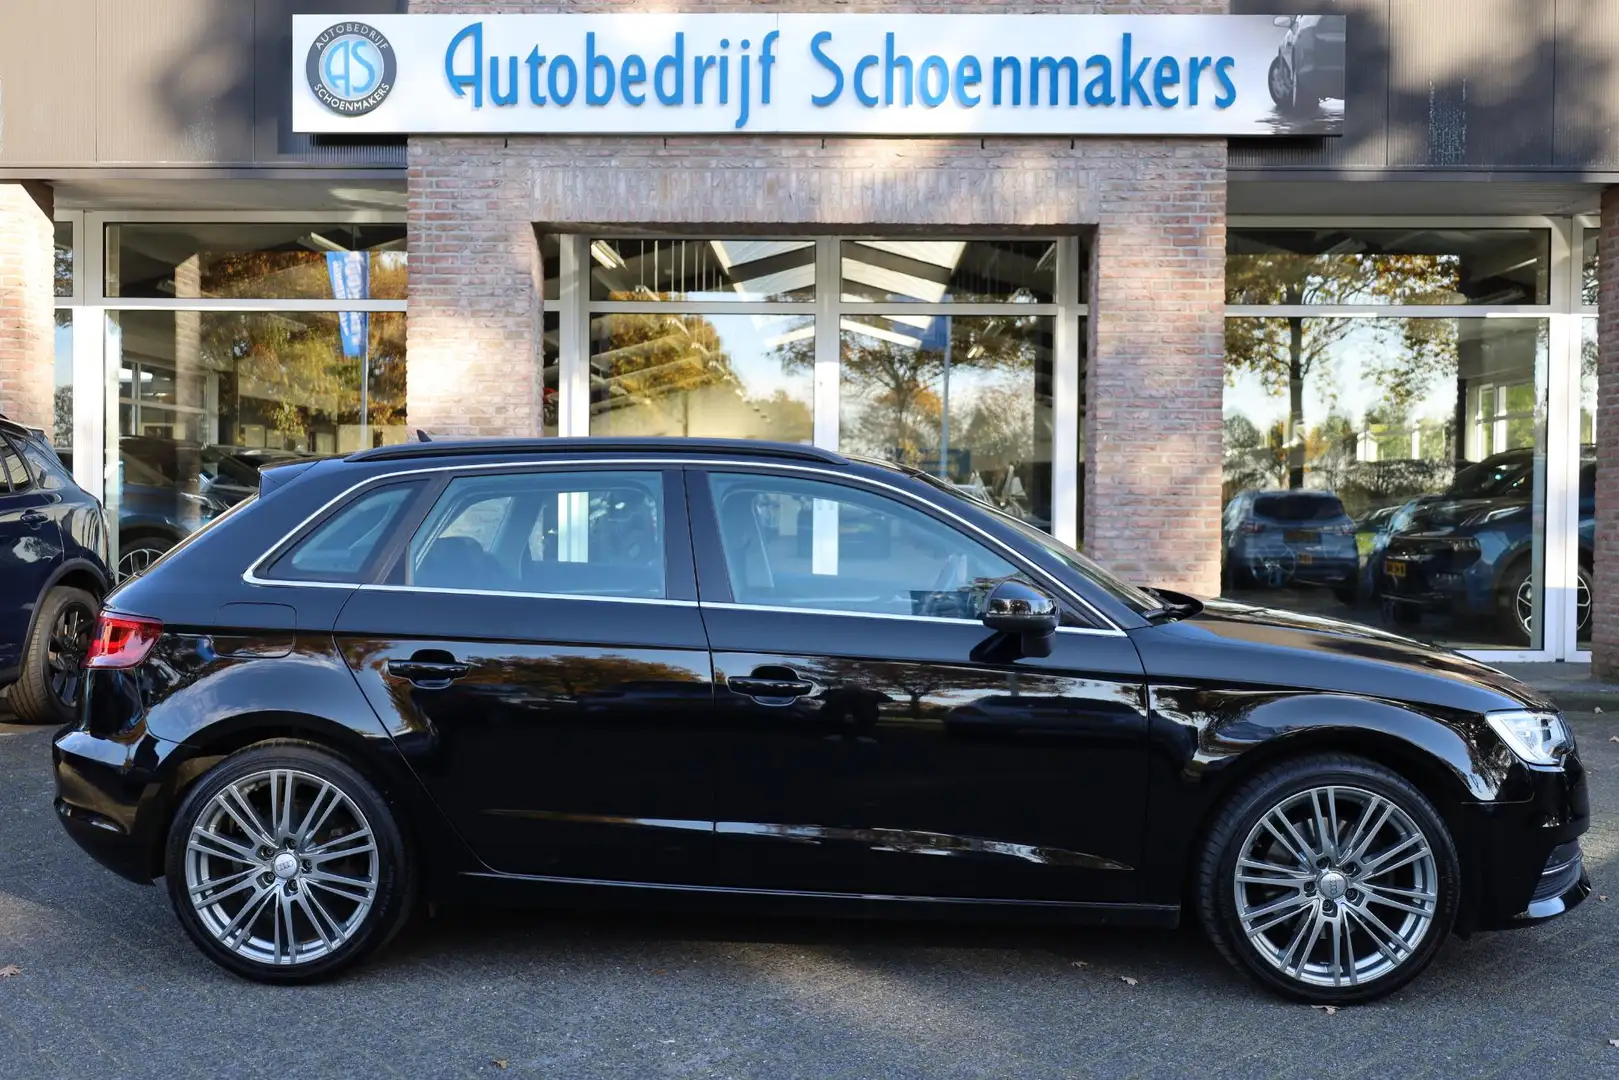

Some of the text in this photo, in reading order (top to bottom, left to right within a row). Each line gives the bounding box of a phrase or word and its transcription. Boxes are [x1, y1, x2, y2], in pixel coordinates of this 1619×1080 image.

[315, 24, 389, 50] AUTOBEDRIJF
[325, 40, 376, 97] AS
[445, 22, 1237, 129] Autobedrijf Schoenmakers
[314, 83, 390, 111] SCHOENMAKERS
